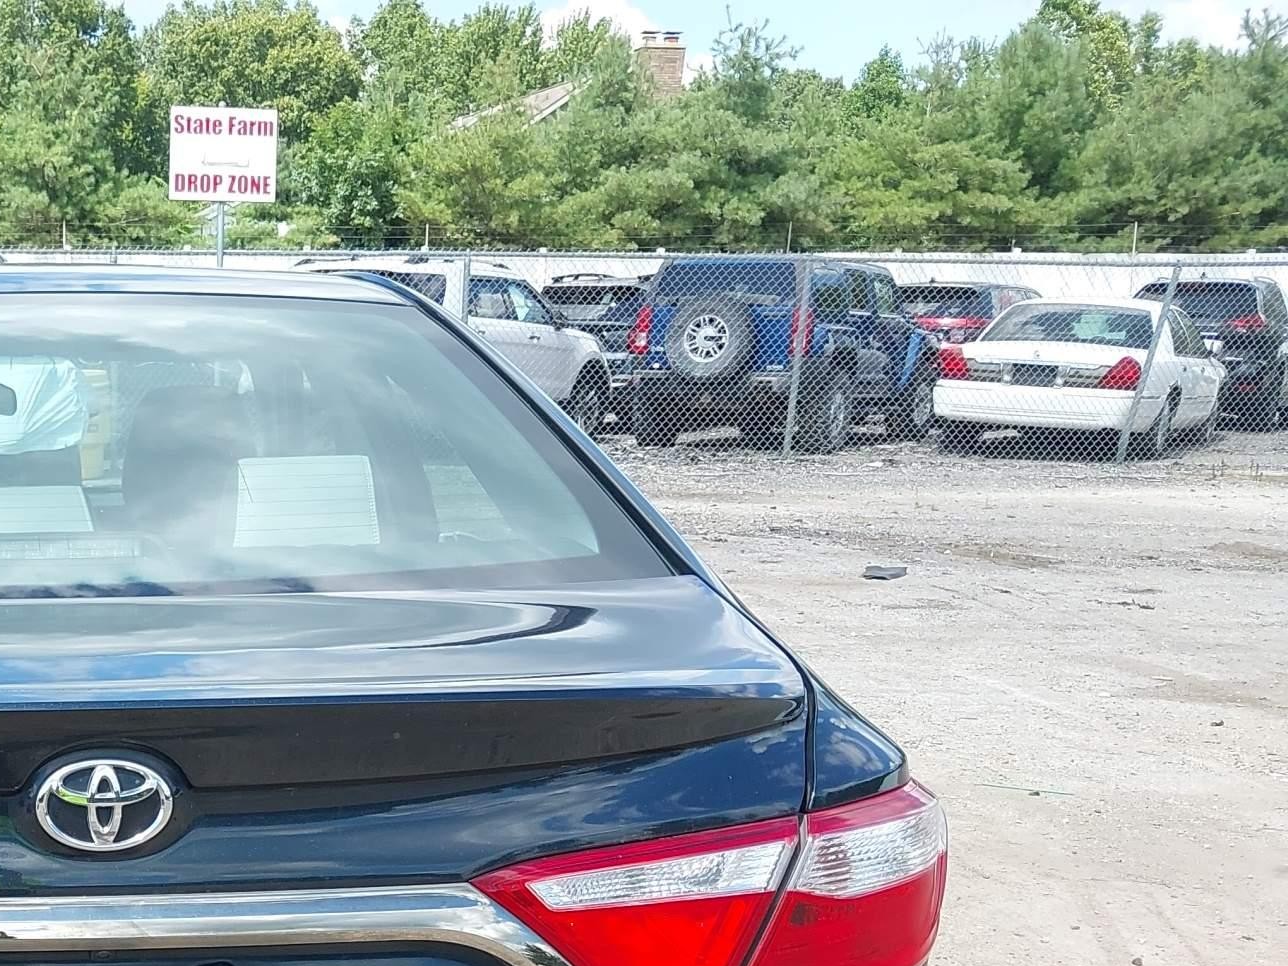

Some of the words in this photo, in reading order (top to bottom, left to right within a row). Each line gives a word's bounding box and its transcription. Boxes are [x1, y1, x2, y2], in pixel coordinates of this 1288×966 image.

[174, 115, 223, 135] State
[228, 116, 274, 137] Farm
[174, 173, 223, 193] DROP
[227, 175, 271, 195] ZONE
